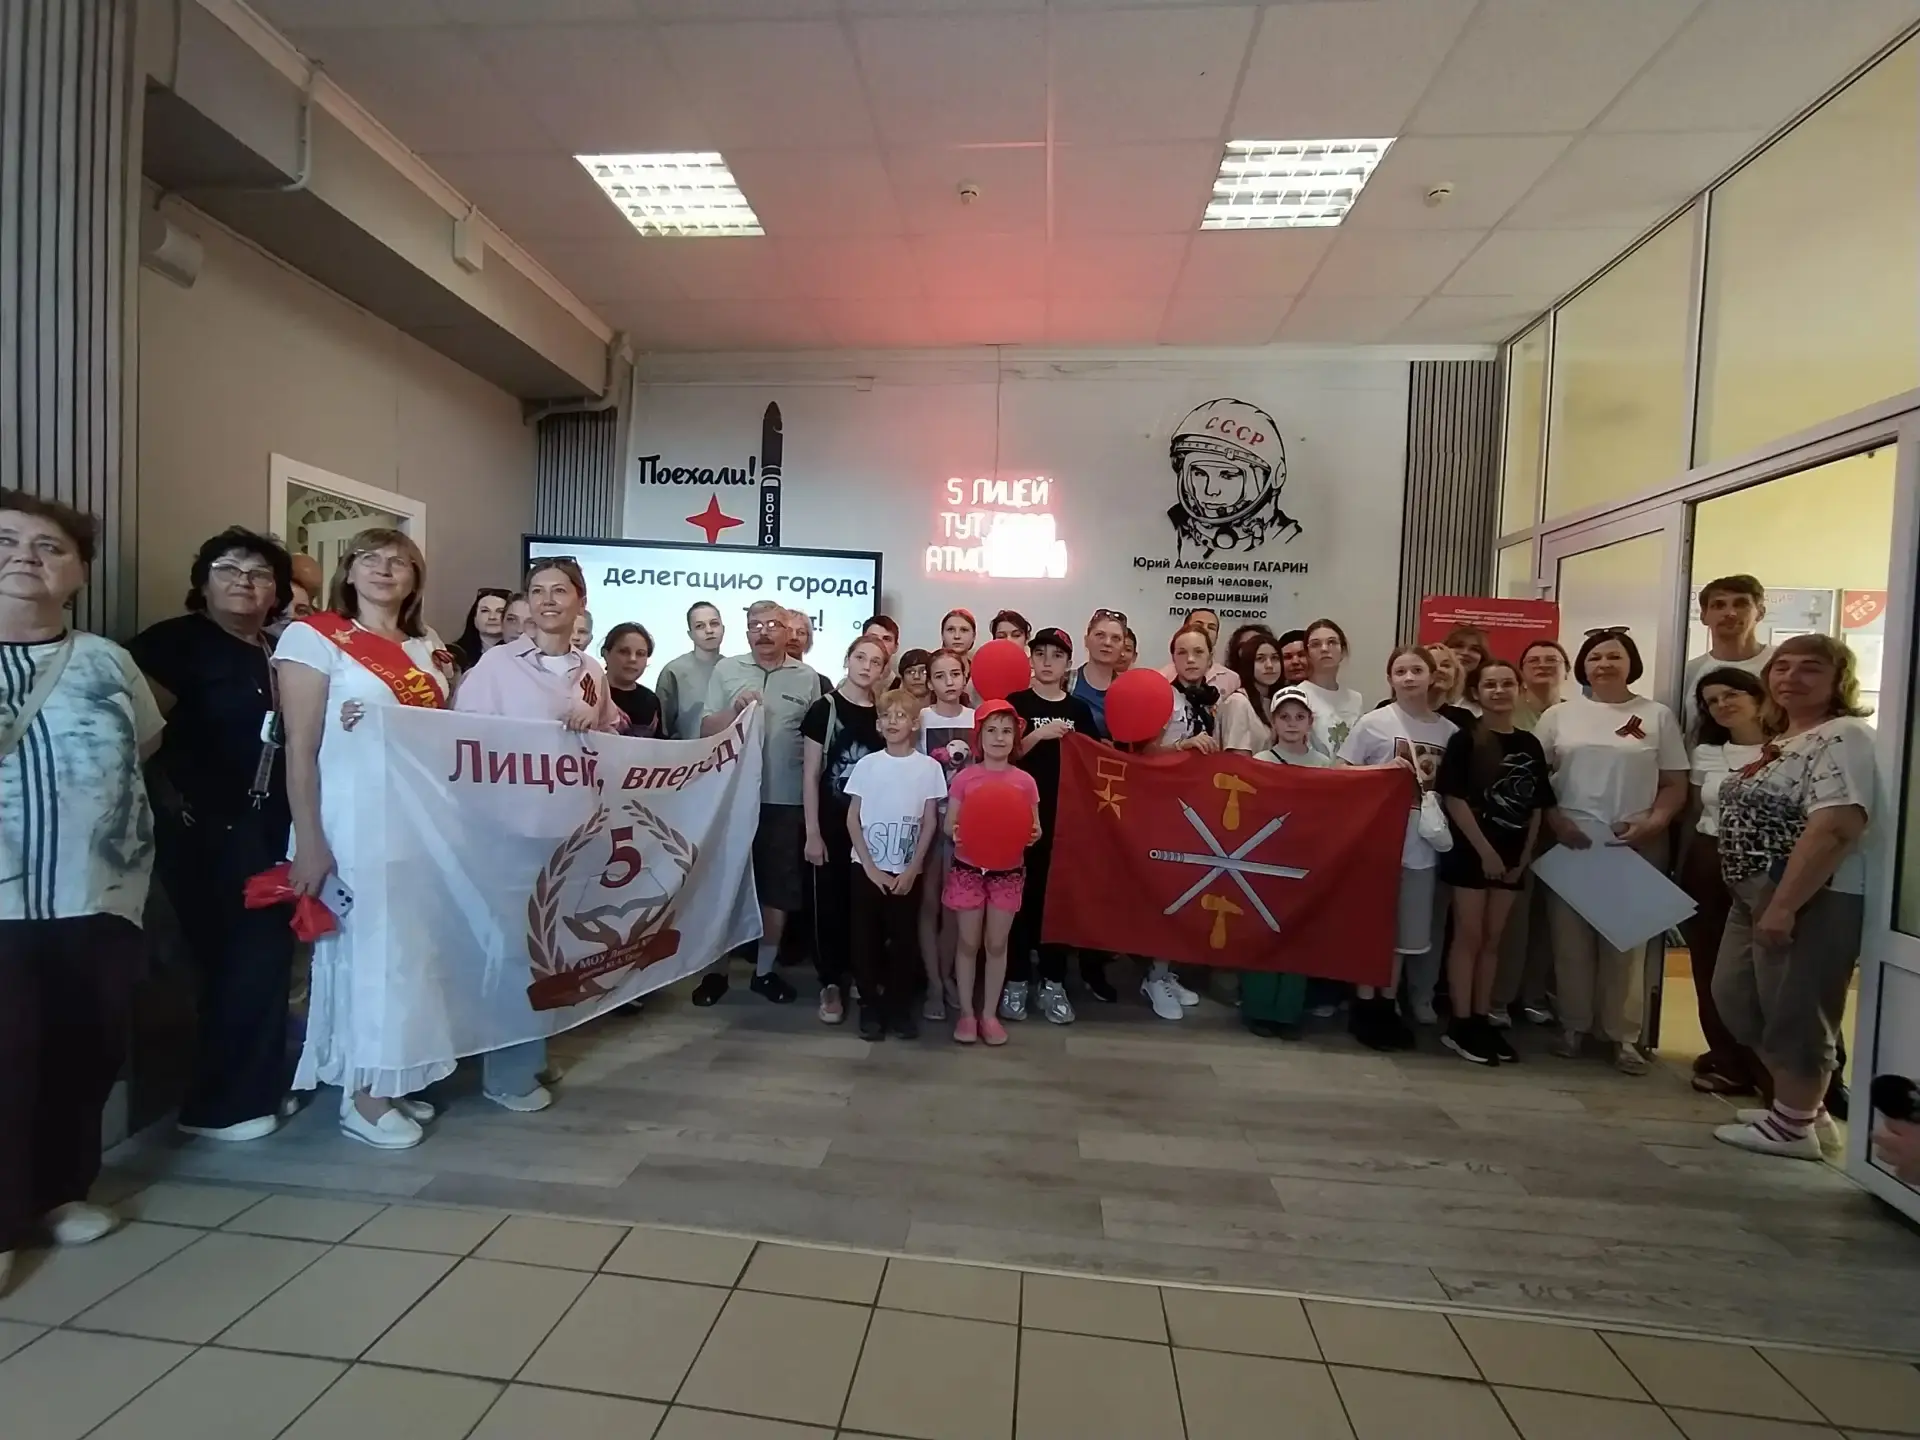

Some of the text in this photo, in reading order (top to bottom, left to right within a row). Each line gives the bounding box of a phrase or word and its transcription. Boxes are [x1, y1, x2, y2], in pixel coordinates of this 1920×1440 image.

[1205, 417, 1265, 445] СССР
[638, 454, 756, 485] Поехали!
[970, 476, 1050, 508] ЛИЦЕЙ
[764, 493, 775, 547] ВОСТО
[940, 511, 985, 540] ТУТ
[603, 567, 763, 590] делегацию
[1133, 557, 1309, 573] Юрий Алексеевич ГАГАРИН
[1166, 575, 1273, 589] первый человек,
[1175, 592, 1269, 604] совершивший
[1219, 608, 1268, 619] космос
[449, 739, 604, 796] Лицей,
[600, 826, 642, 888] 5
